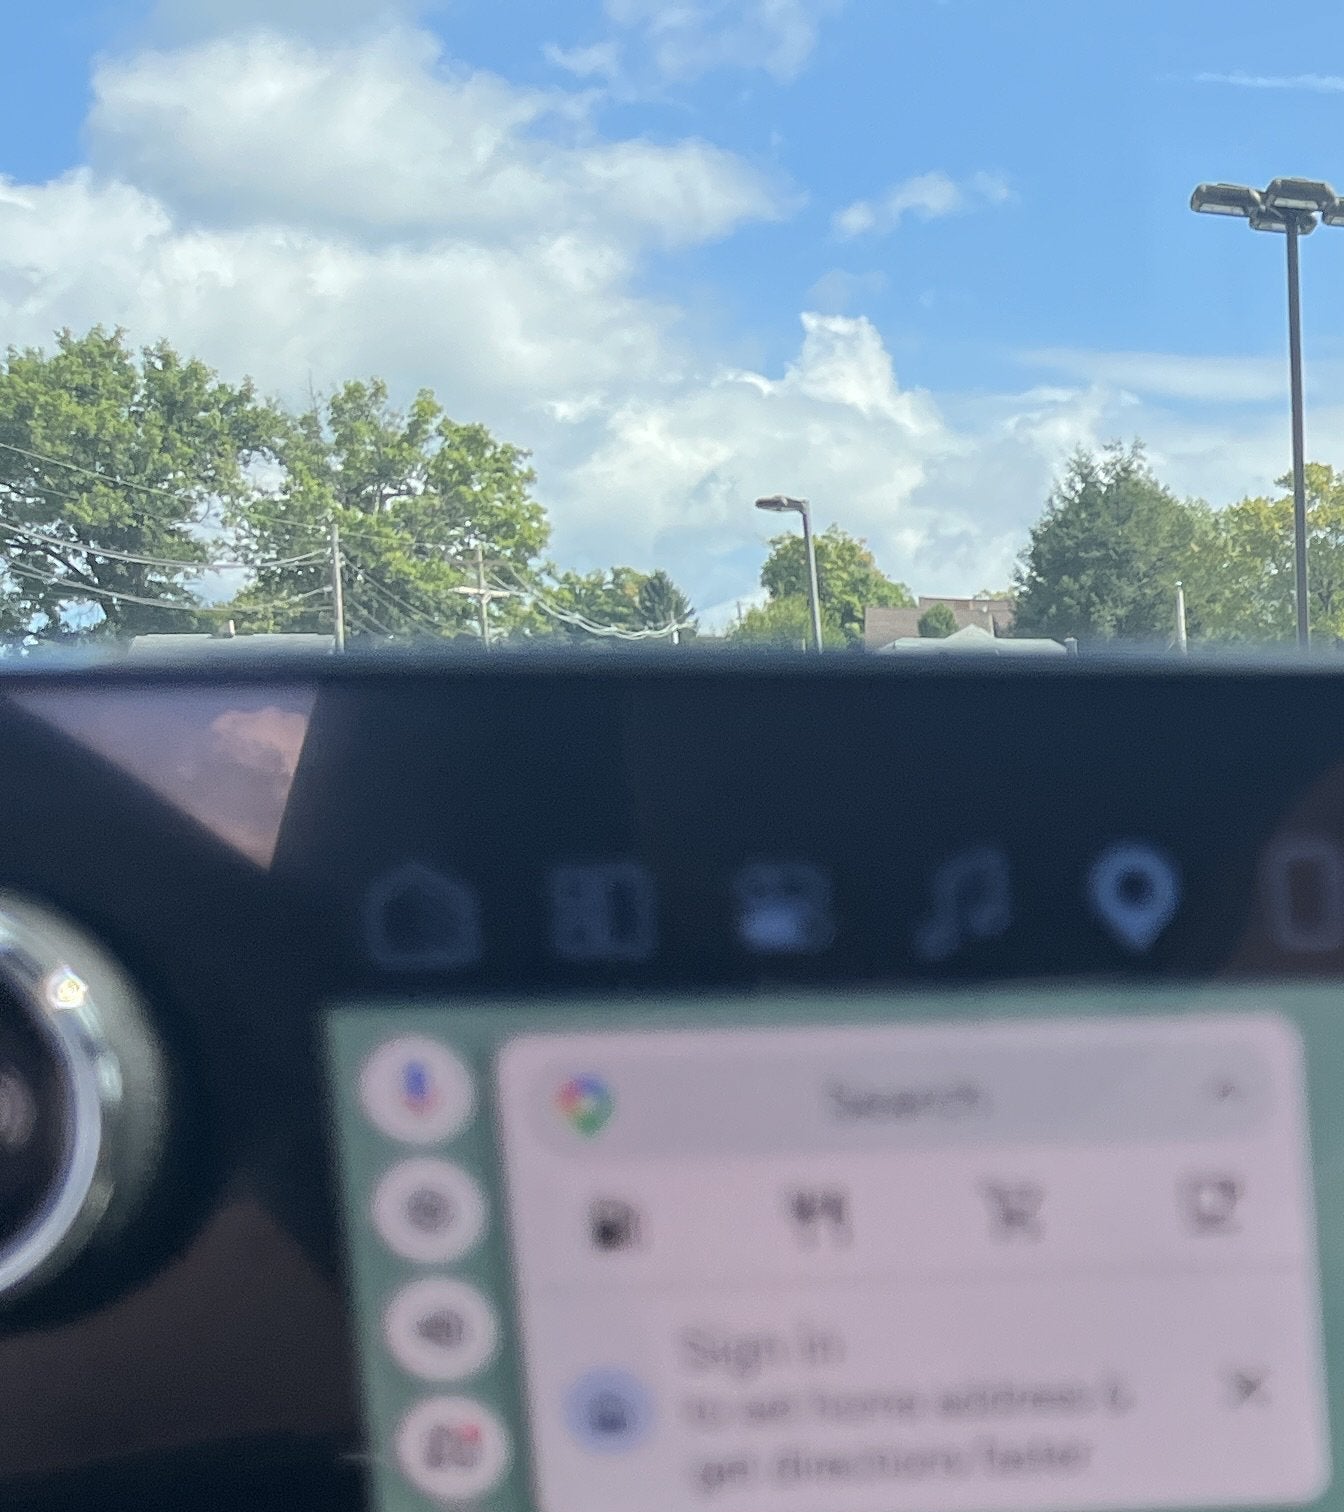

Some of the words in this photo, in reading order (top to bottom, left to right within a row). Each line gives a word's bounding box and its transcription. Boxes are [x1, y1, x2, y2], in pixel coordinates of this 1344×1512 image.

[824, 1074, 991, 1124] Search
[678, 1325, 787, 1386] Sign
[796, 1322, 847, 1366] in
